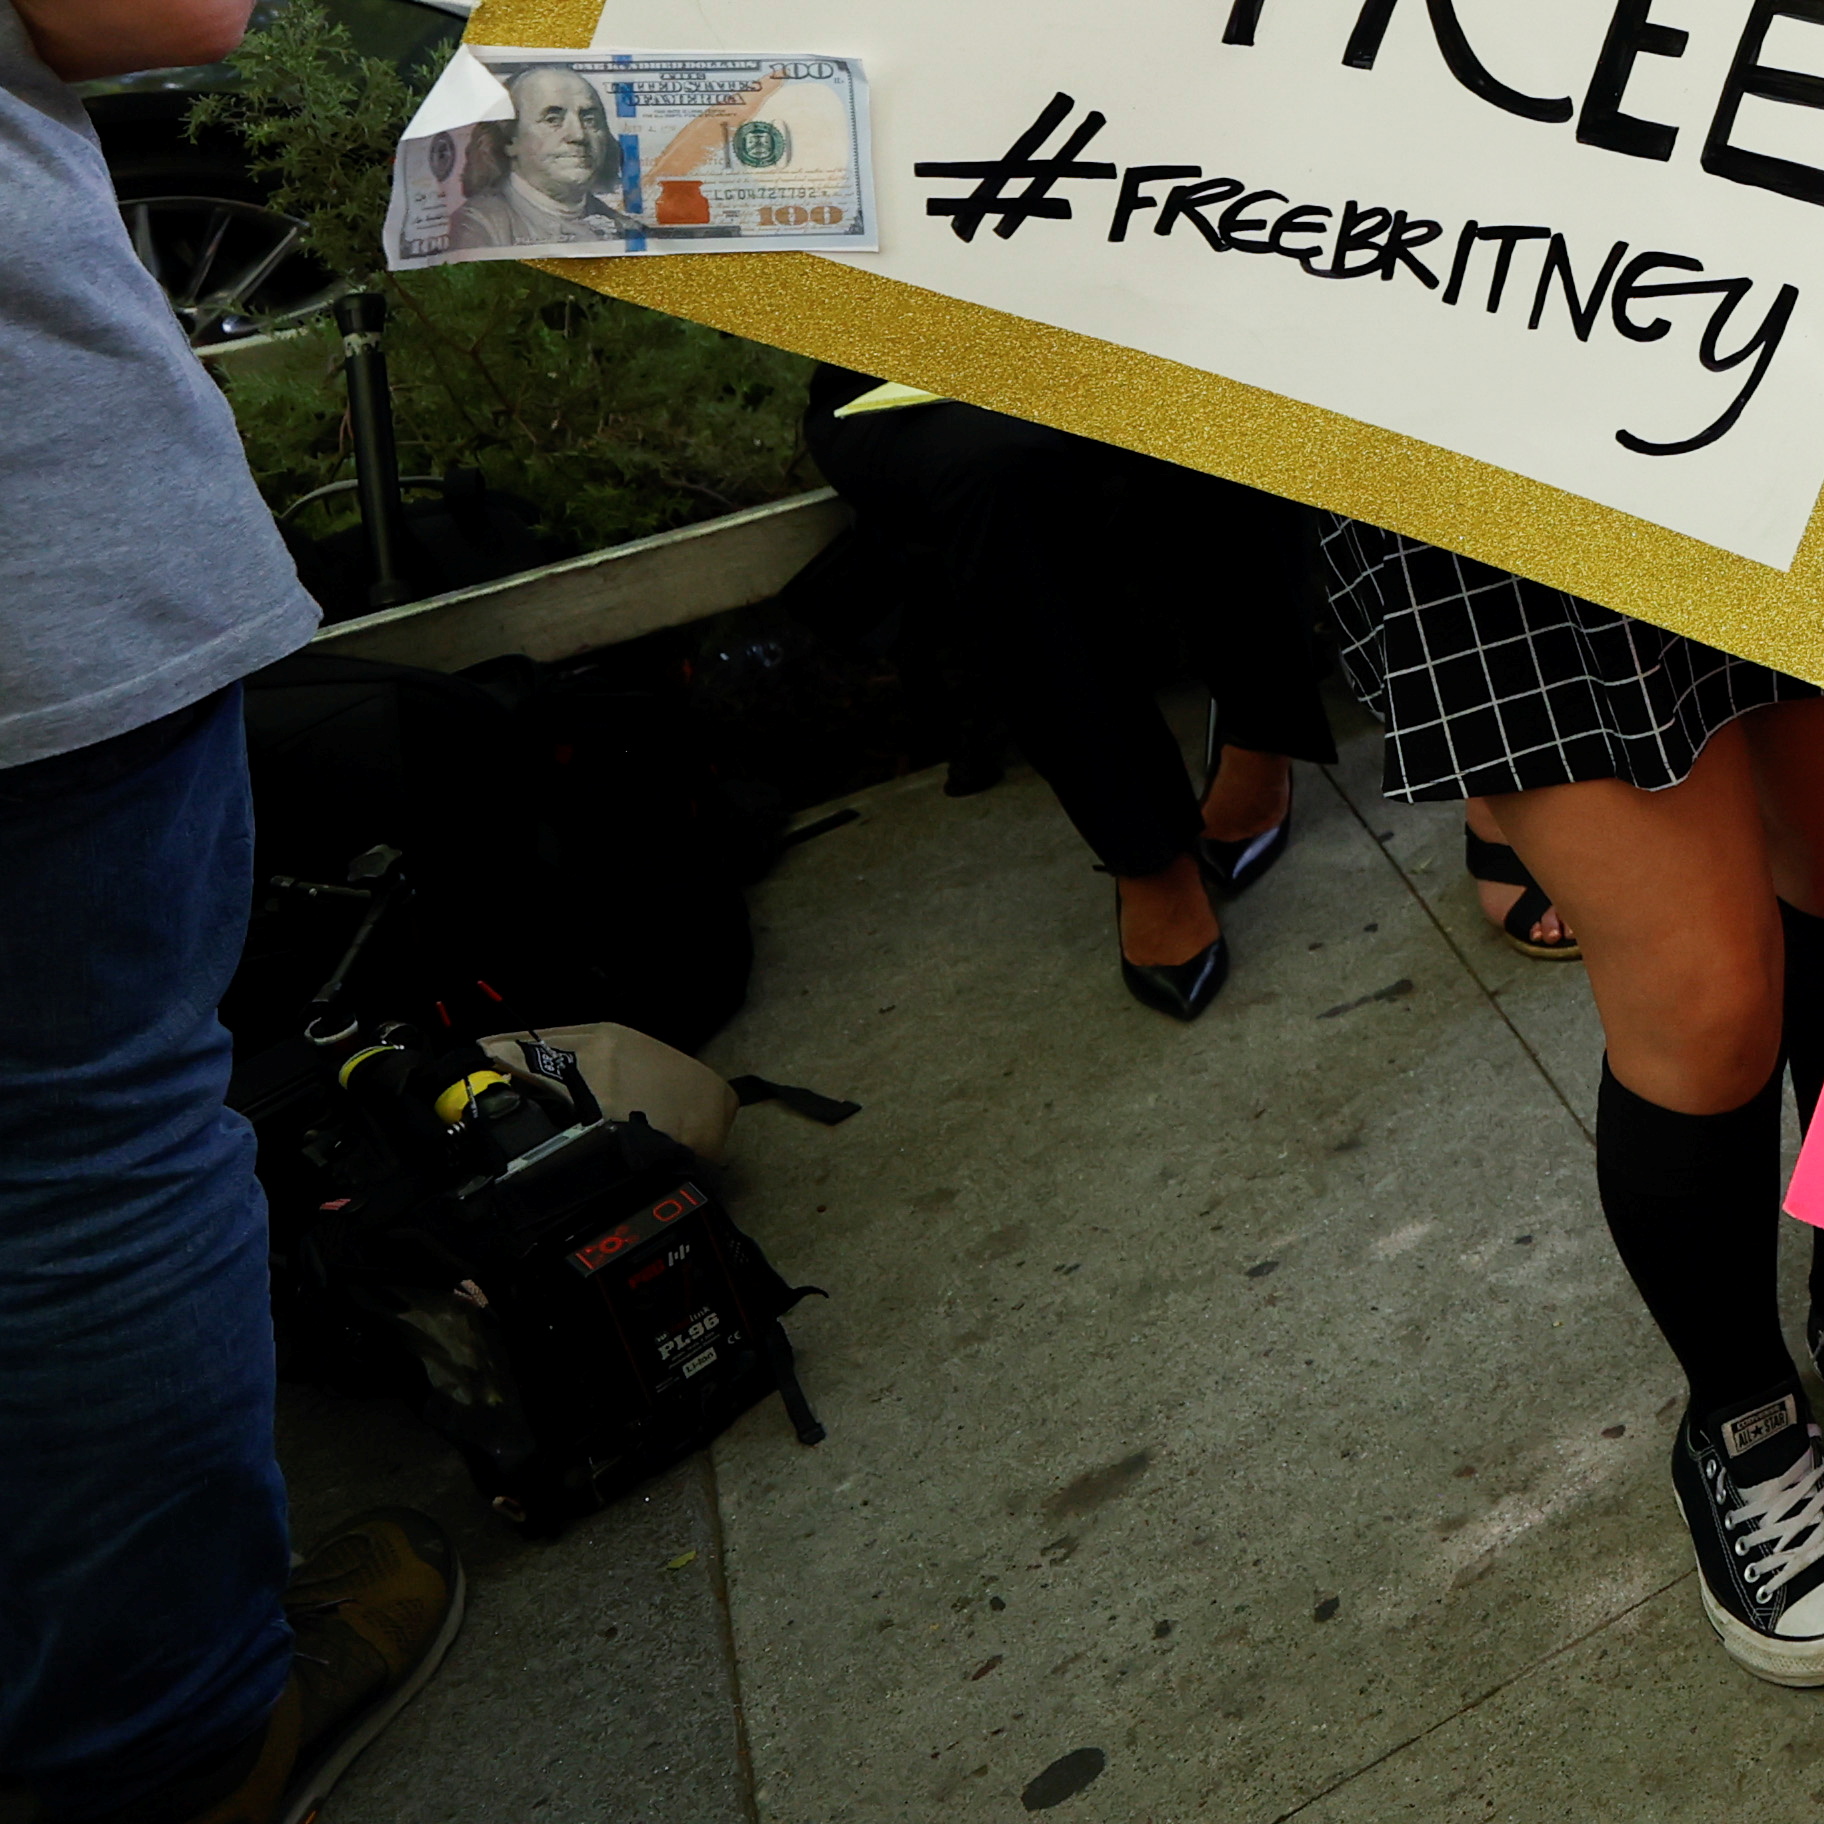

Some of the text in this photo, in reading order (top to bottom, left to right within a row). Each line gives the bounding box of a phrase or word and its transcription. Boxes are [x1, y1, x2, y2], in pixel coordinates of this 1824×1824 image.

[769, 62, 834, 80] 100
[757, 206, 843, 226] 100
[1764, 1411, 1785, 1434] STAR
